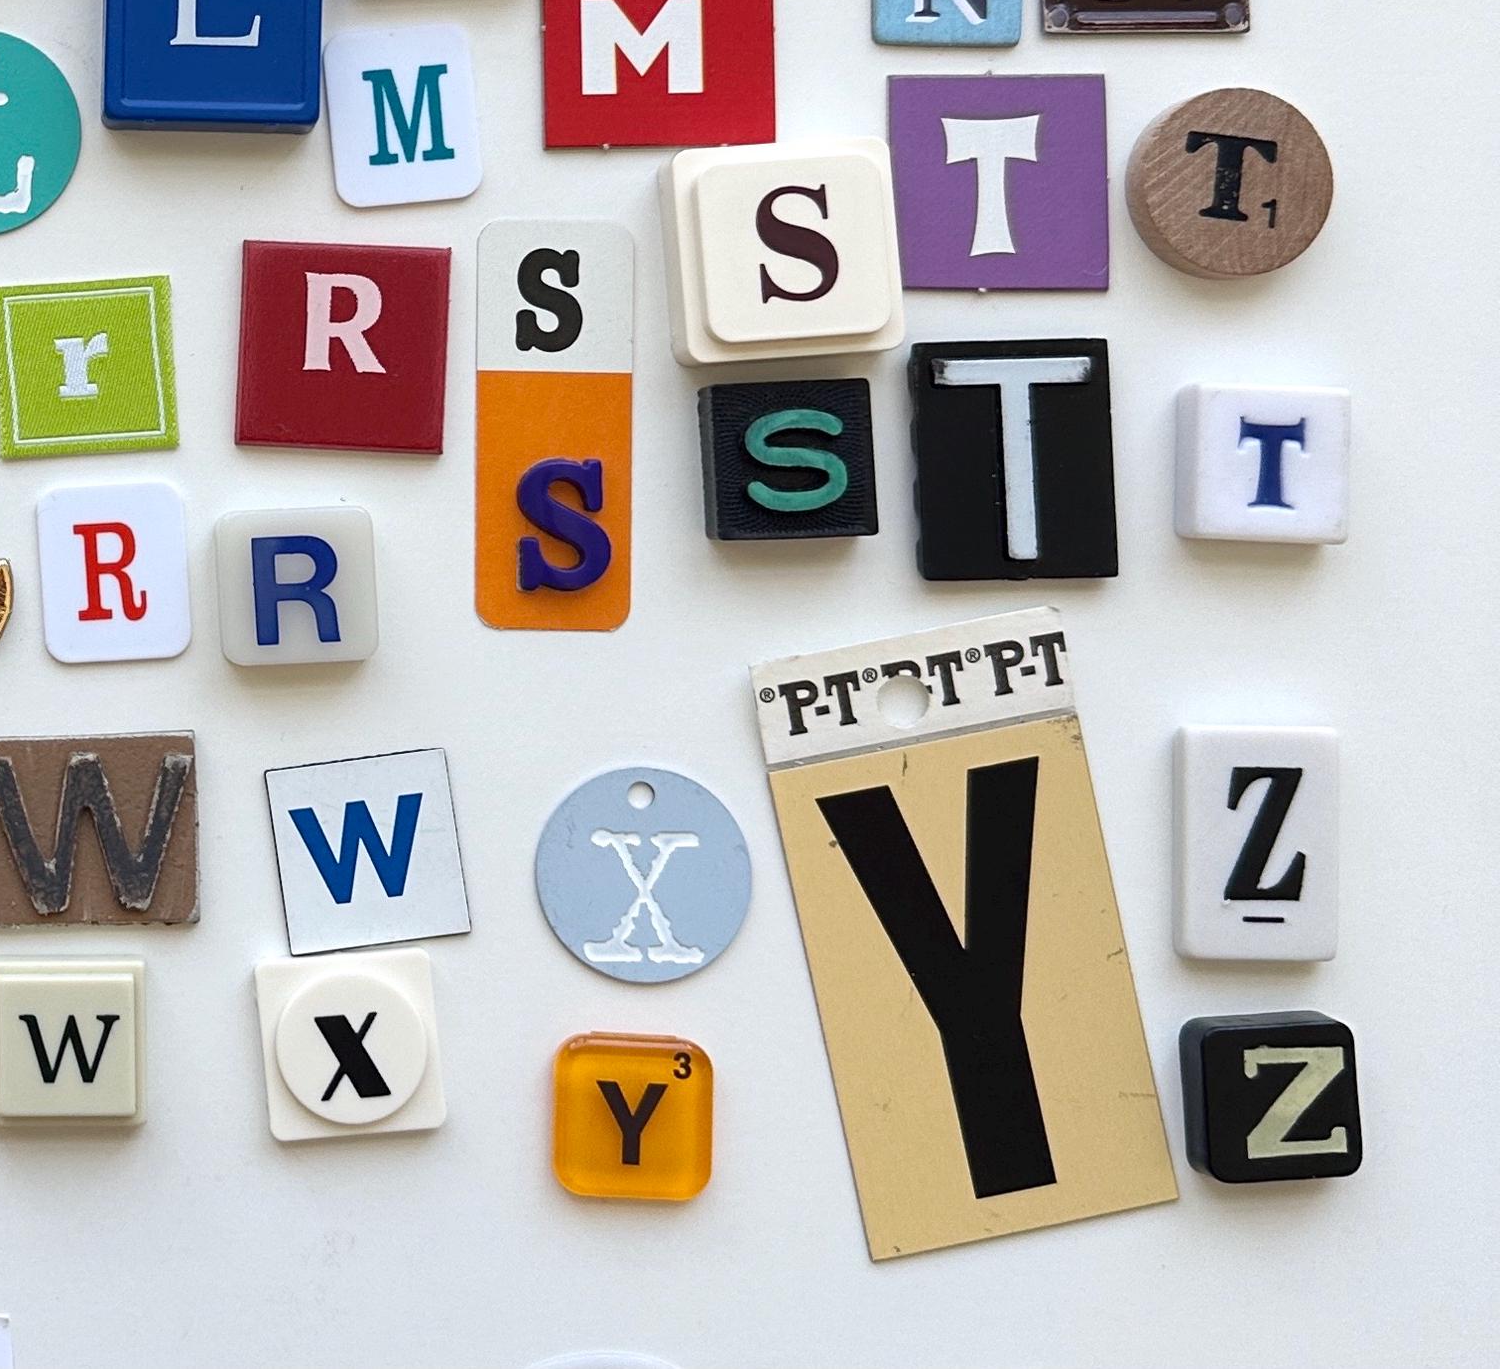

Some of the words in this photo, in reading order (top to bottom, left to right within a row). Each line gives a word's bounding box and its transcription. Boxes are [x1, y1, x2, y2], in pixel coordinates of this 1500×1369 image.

[361, 63, 456, 166] M
[940, 113, 1041, 258] T
[1185, 130, 1278, 222] T
[755, 183, 839, 304] S
[302, 271, 387, 375] R
[515, 246, 584, 353] S
[53, 331, 109, 400] r
[743, 407, 849, 512] S
[930, 356, 1095, 561] T
[1238, 415, 1309, 510] T
[71, 521, 148, 623] R
[515, 456, 612, 593] S
[250, 534, 343, 647] R
[287, 792, 424, 905] W
[1222, 766, 1307, 902] Z
[581, 829, 705, 964] X
[814, 755, 1058, 1200] Y
[18, 1012, 121, 1086] W
[313, 1011, 392, 1103] X
[1242, 1043, 1349, 1160] Z
[595, 1079, 668, 1167] Y
